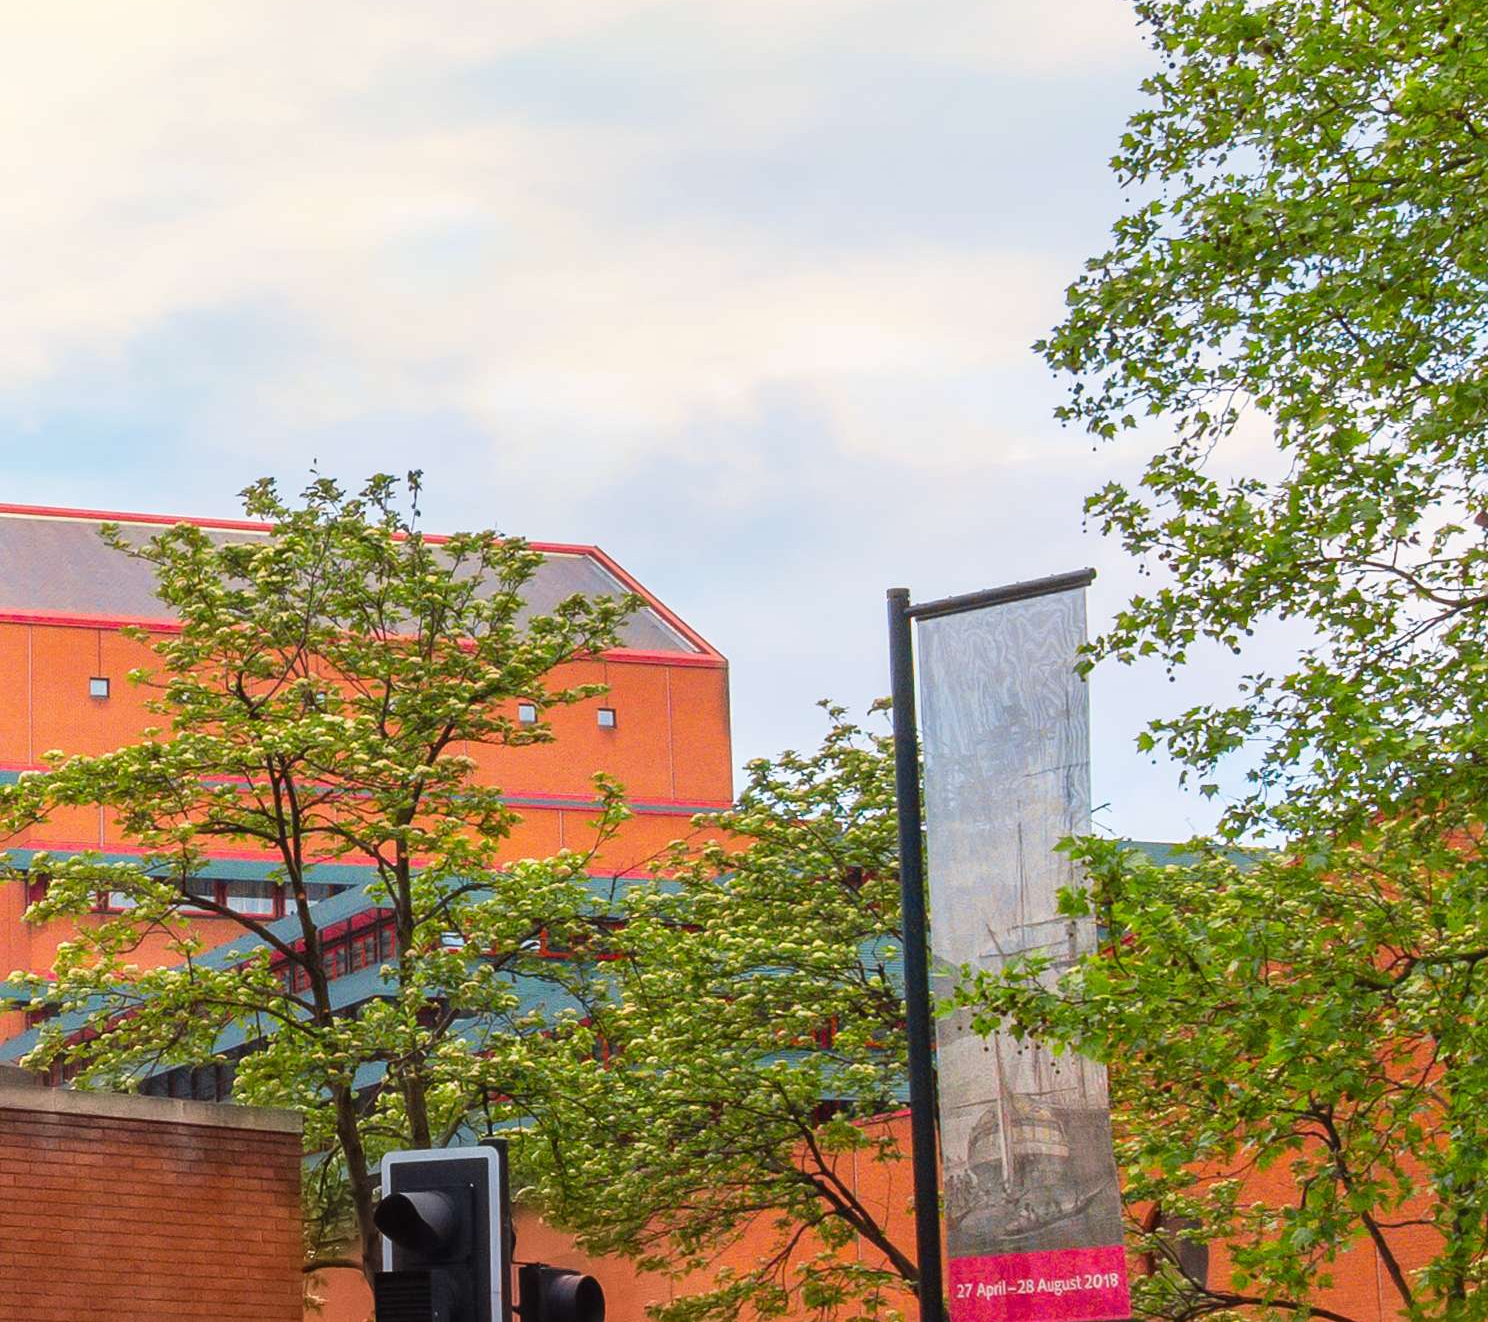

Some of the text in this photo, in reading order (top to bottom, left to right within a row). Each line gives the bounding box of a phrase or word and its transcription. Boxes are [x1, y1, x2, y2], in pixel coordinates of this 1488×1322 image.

[956, 1283, 974, 1299] 27
[1036, 1275, 1082, 1296] August
[1084, 1272, 1119, 1290] 2018
